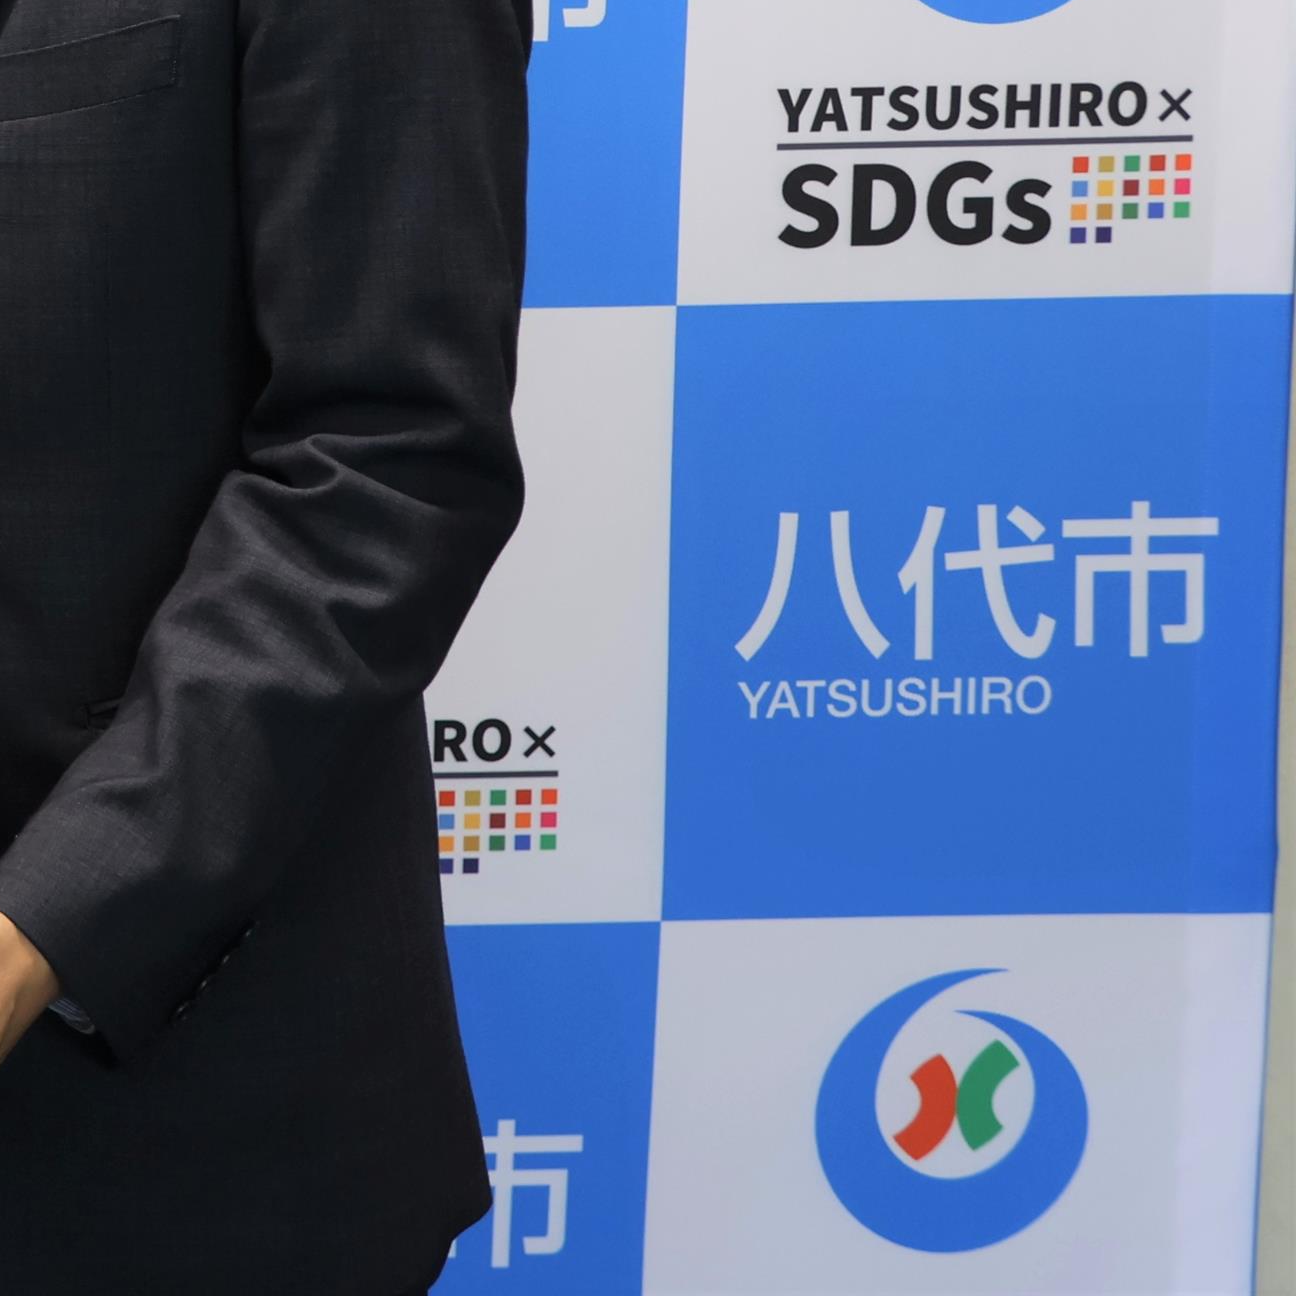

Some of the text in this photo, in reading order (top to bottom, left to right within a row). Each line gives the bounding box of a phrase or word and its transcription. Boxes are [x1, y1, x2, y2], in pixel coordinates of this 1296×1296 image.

[779, 162, 1052, 249] SDGs
[737, 502, 1219, 661] 八代市
[740, 676, 1053, 719] YATSUSHIRO
